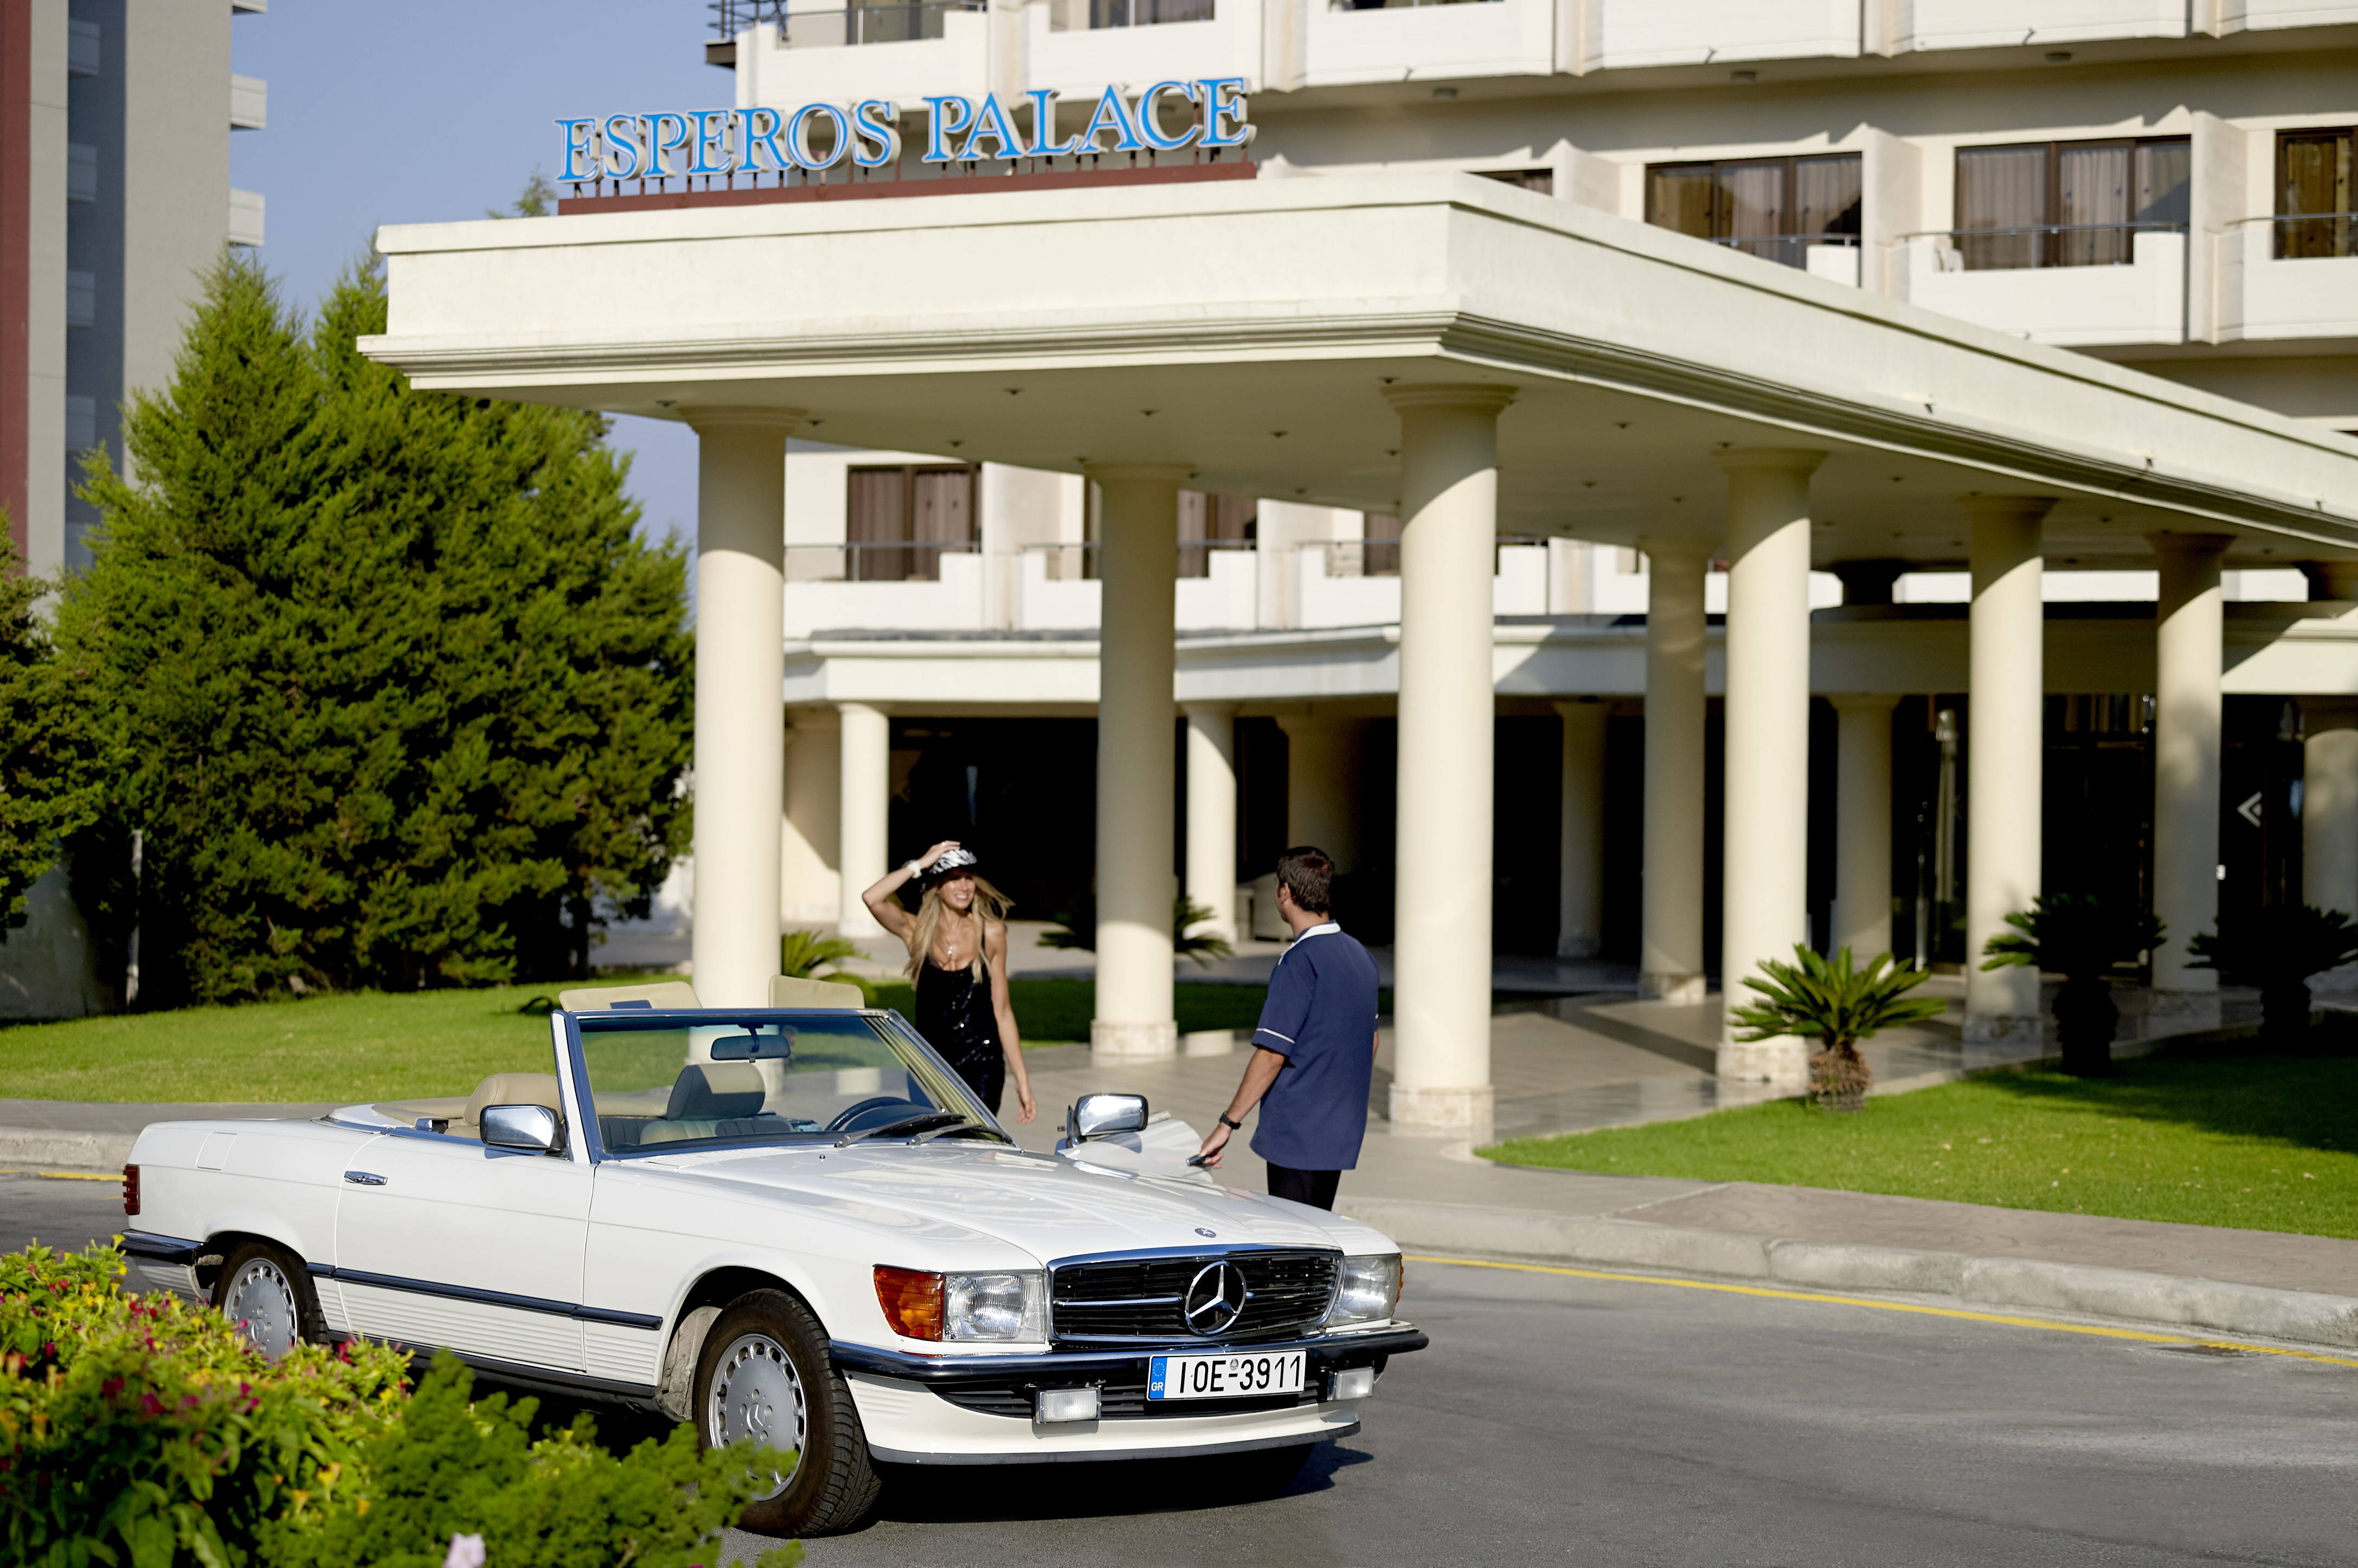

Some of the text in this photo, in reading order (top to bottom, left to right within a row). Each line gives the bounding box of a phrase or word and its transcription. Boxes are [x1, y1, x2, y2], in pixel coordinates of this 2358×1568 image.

[554, 77, 1257, 183] ESPEROS PALACE
[1151, 1381, 1164, 1392] GR
[1179, 1355, 1301, 1393] IOE-3911
